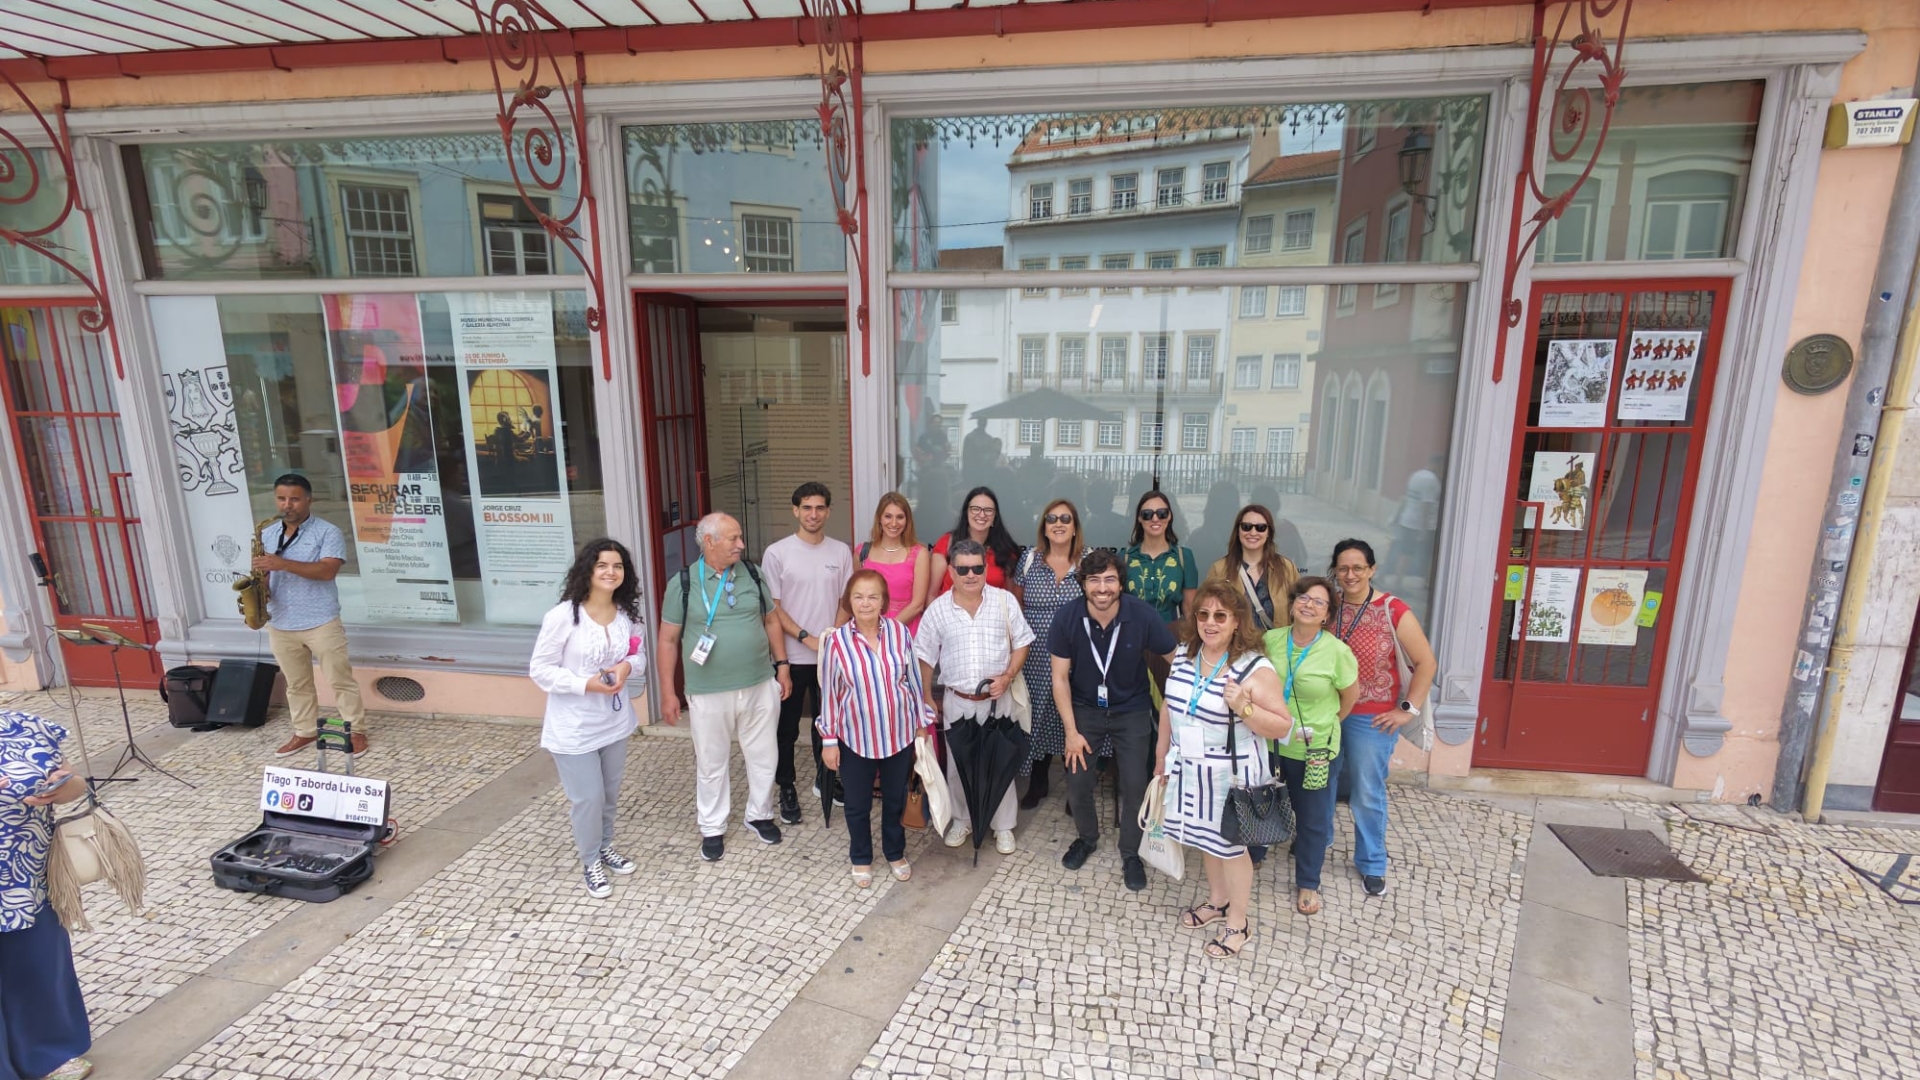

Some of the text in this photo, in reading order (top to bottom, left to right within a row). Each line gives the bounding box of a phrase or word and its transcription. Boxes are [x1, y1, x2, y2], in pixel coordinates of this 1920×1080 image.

[1856, 109, 1901, 119] STANLEY
[351, 484, 422, 496] SEGURAR
[378, 494, 408, 505] DAR
[374, 504, 442, 515] RECEBER
[483, 512, 540, 523] BLOSSOM
[206, 572, 240, 583] COIM
[266, 772, 384, 797] Tiago Taborda Live Sax
